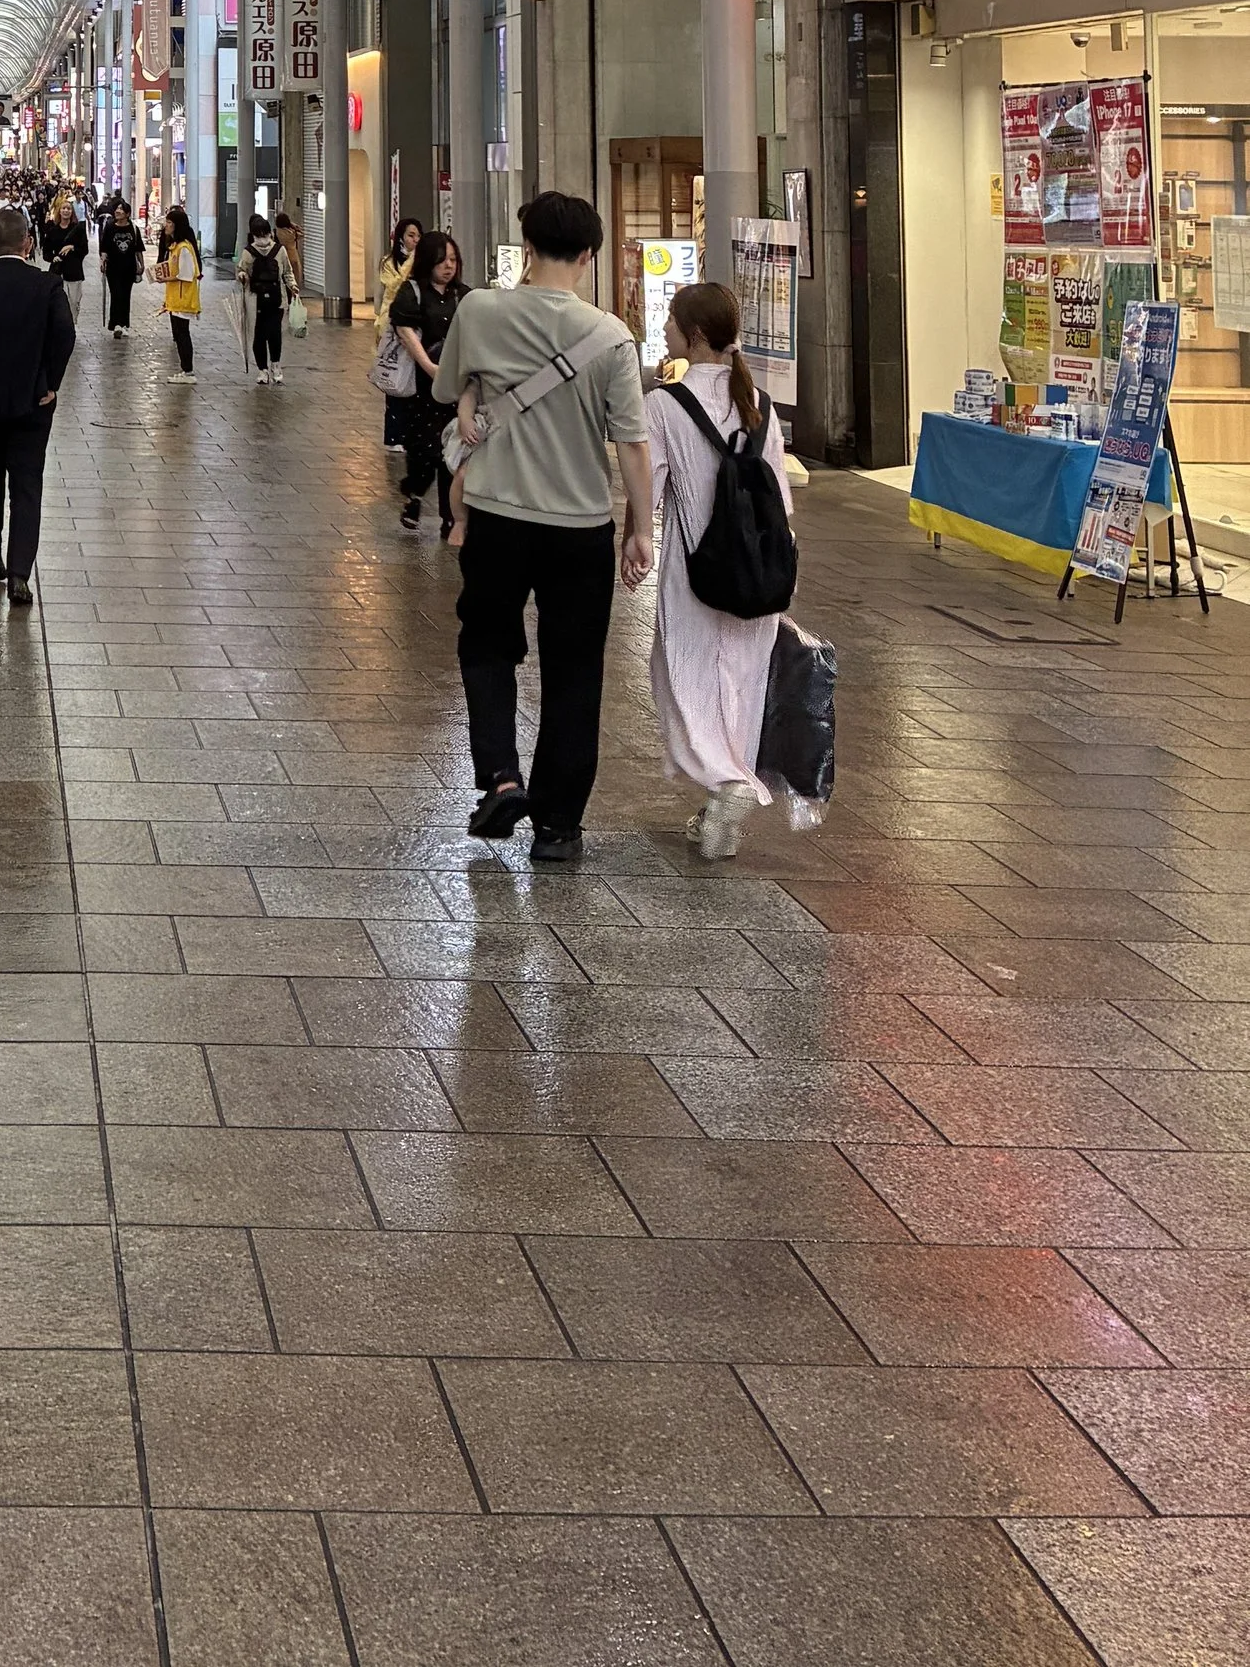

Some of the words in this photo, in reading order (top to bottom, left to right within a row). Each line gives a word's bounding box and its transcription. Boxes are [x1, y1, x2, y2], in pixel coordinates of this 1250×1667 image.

[1158, 107, 1206, 115] CCESSORIES
[1053, 277, 1100, 301] 予約なしの
